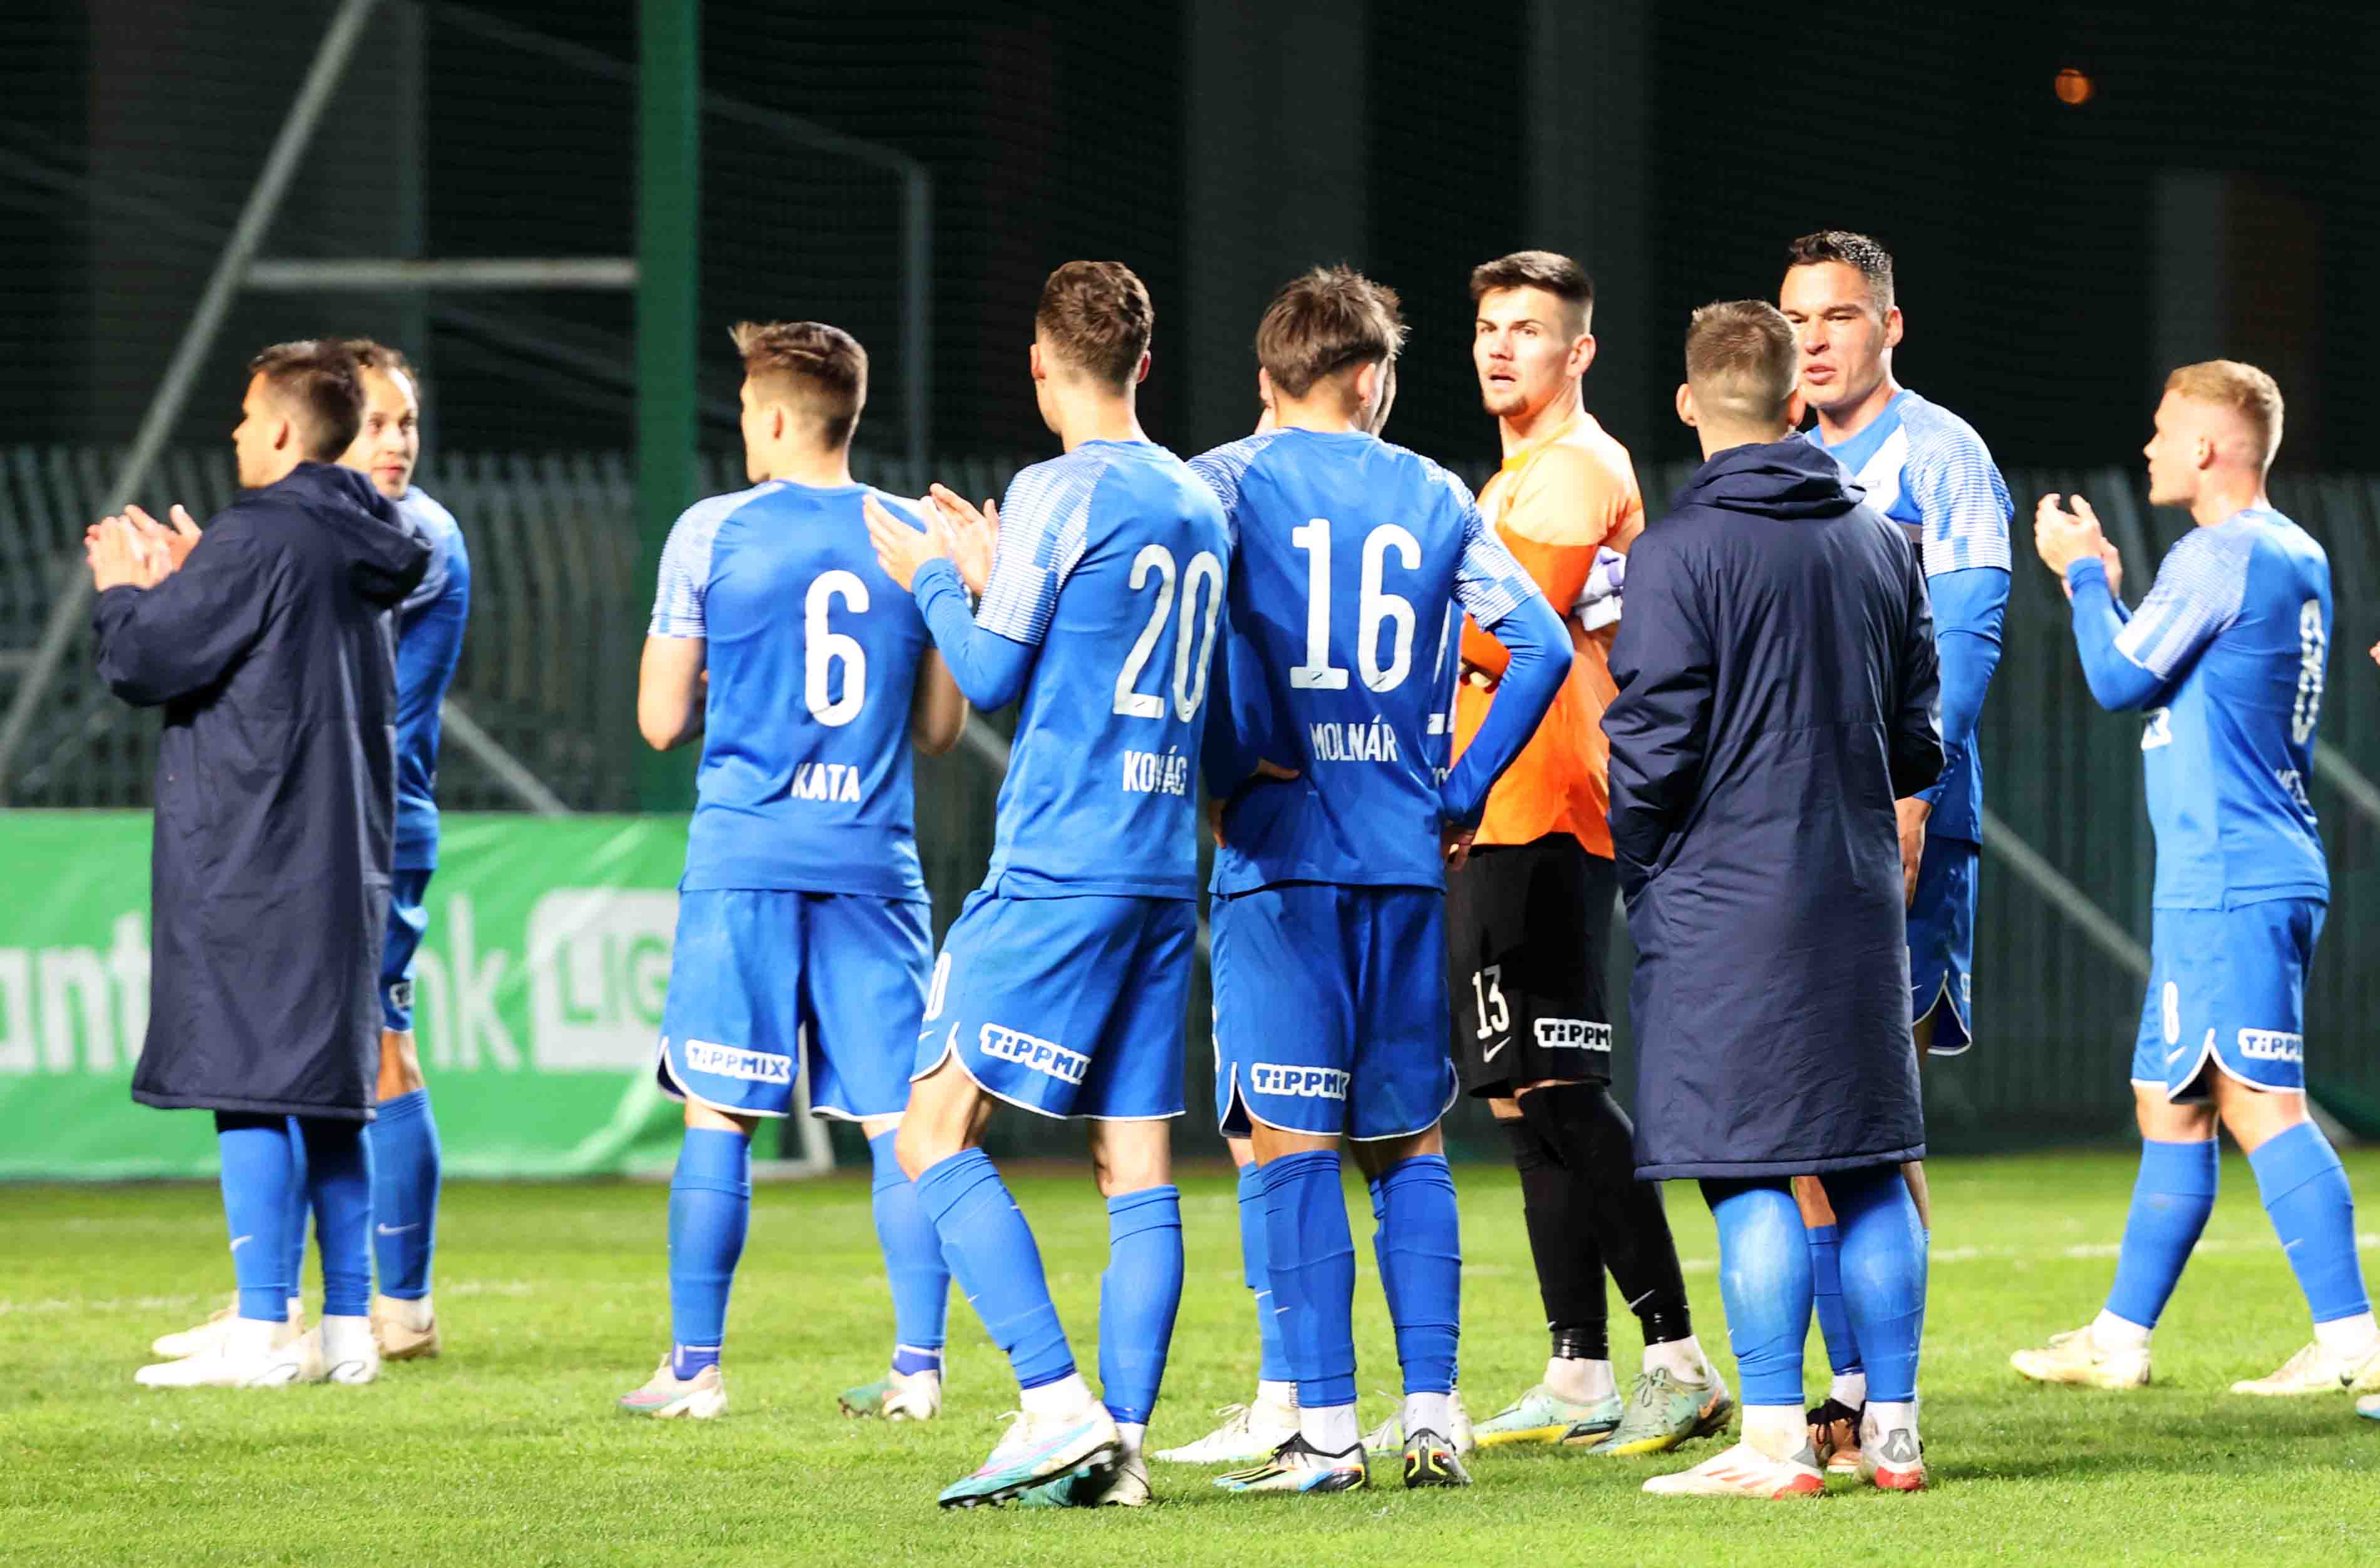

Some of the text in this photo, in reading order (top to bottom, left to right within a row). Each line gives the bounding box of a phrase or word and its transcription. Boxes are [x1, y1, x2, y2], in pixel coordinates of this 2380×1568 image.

[804, 569, 871, 727] 6
[1112, 544, 1224, 723] 20
[1290, 518, 1422, 693] 16
[790, 762, 861, 802] KATA
[1308, 713, 1399, 763] MOLNÁR
[1472, 964, 1510, 1040] 13
